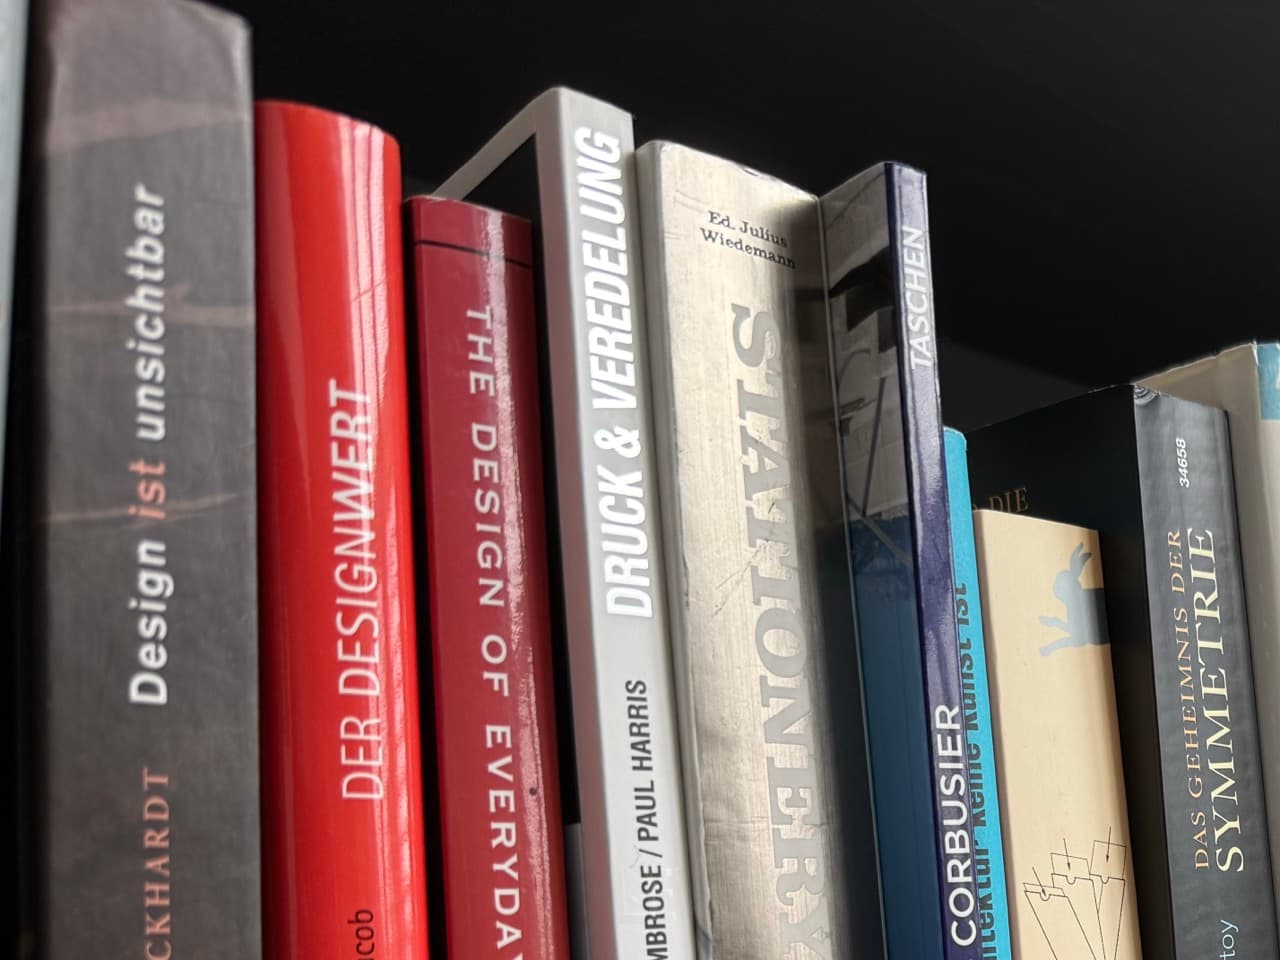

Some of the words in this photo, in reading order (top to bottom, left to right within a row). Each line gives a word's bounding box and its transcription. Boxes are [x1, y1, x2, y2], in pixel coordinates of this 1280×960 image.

[574, 126, 638, 410] VEREDELUNG
[699, 227, 796, 270] Wiedemann
[707, 210, 736, 230] Ed.
[739, 219, 788, 248] Julius
[127, 185, 167, 442] unsichtbar
[898, 225, 933, 370] TASCHEN
[466, 307, 495, 395] THE
[129, 458, 166, 521] ist
[593, 429, 642, 458] &
[1176, 437, 1190, 488] 34658
[329, 379, 382, 697] DESIGNWERT
[468, 424, 506, 608] DESIGN
[595, 466, 654, 618] DRUCK
[1167, 530, 1187, 595] DER
[128, 540, 174, 706] Design
[480, 634, 511, 696] OF
[625, 680, 654, 771] HARRIS
[1173, 607, 1202, 799] GEHEIMNIS
[1187, 528, 1246, 873] SYMMETRIE
[341, 704, 384, 802] DER
[637, 780, 660, 842] PAUL
[935, 704, 981, 948] CORBUSIER
[1190, 810, 1210, 870] DAS
